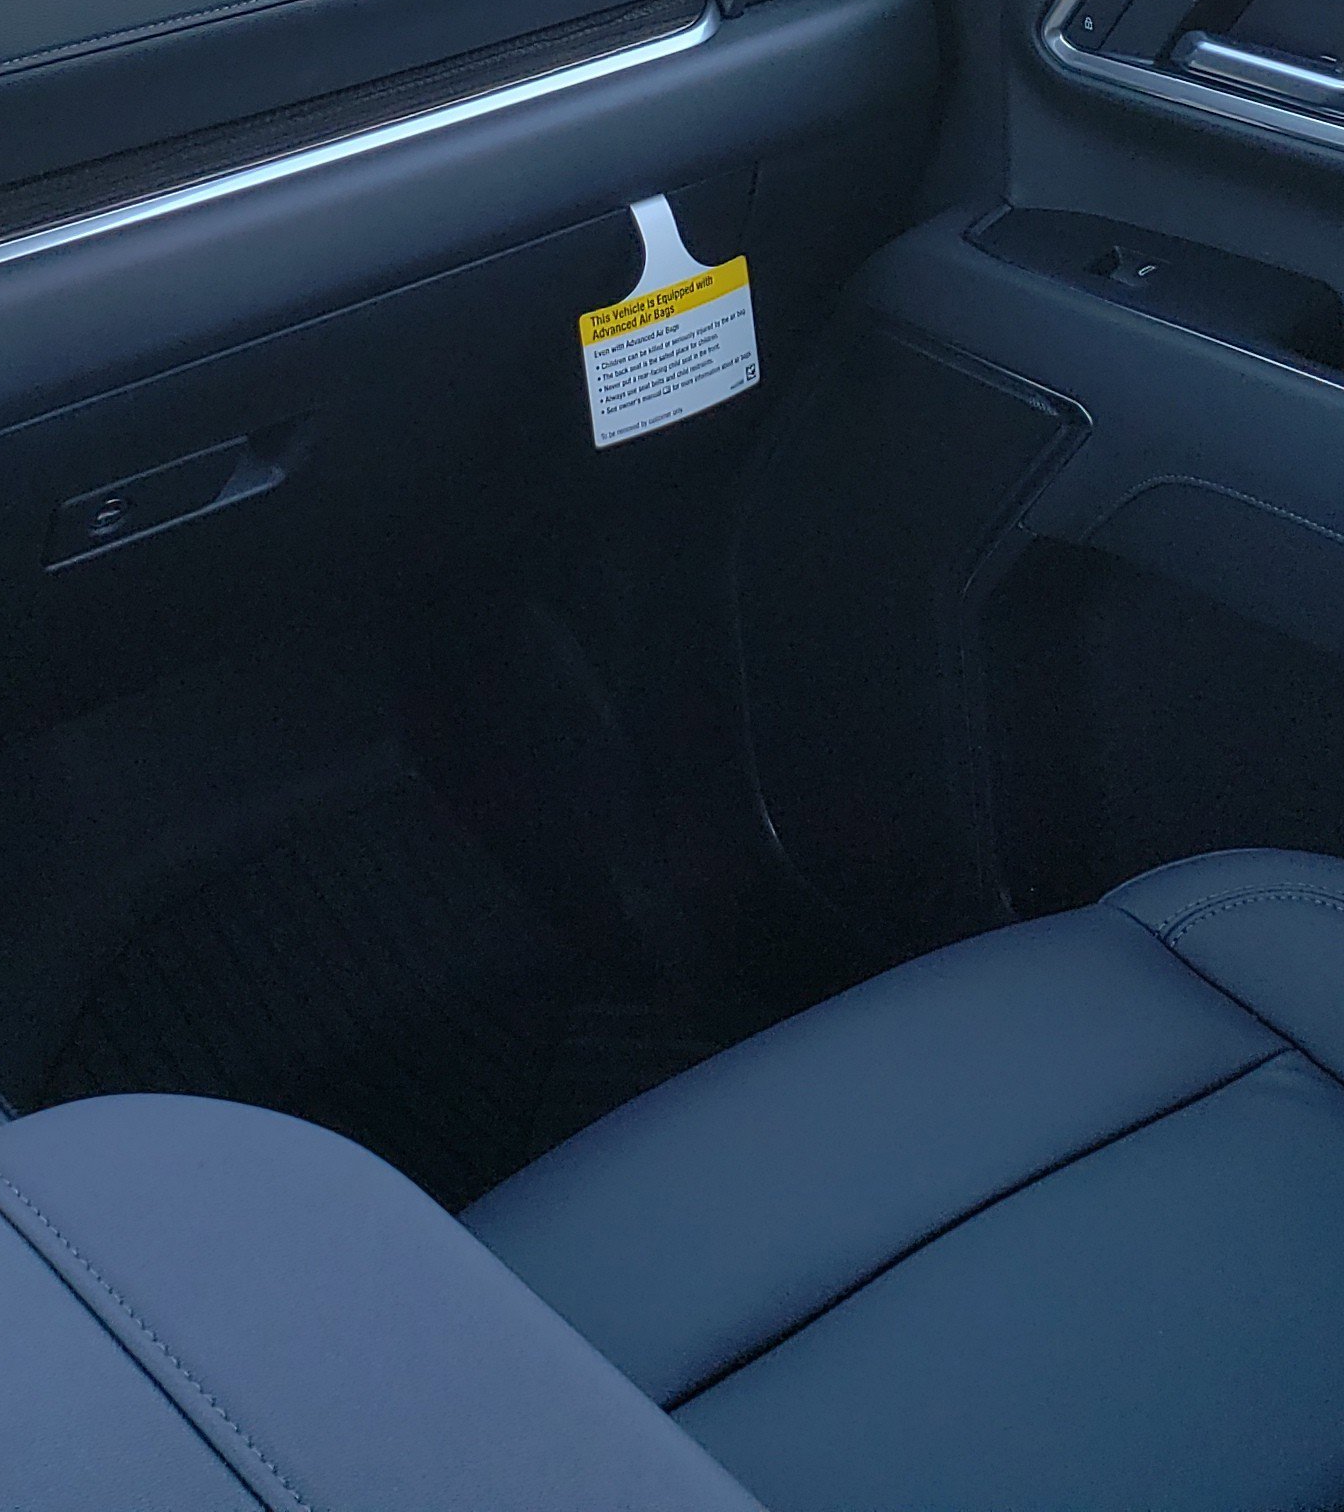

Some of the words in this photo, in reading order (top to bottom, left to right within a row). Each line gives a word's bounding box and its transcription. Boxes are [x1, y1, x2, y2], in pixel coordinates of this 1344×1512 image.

[590, 313, 610, 327] This
[612, 302, 645, 320] Vehicle
[656, 281, 694, 305] Equipped
[696, 276, 713, 290] with
[593, 317, 637, 340] Advanced
[639, 311, 652, 326] Air
[654, 305, 675, 319] Bags
[593, 348, 609, 359] Even
[610, 342, 624, 353] with
[625, 331, 655, 349] Advanced
[655, 329, 664, 338] Air
[665, 324, 679, 335] Bags
[601, 357, 626, 370] Children
[627, 352, 638, 361] can
[648, 342, 663, 354] killed
[721, 316, 729, 325] the
[603, 372, 613, 381] The
[614, 366, 628, 377] back
[648, 357, 657, 365] the
[675, 345, 689, 356] place
[603, 381, 620, 392] Never
[621, 376, 632, 387] put
[668, 359, 680, 369] child
[605, 391, 625, 404] Always
[650, 377, 664, 387] belts
[665, 371, 675, 382] and
[676, 367, 688, 377] child
